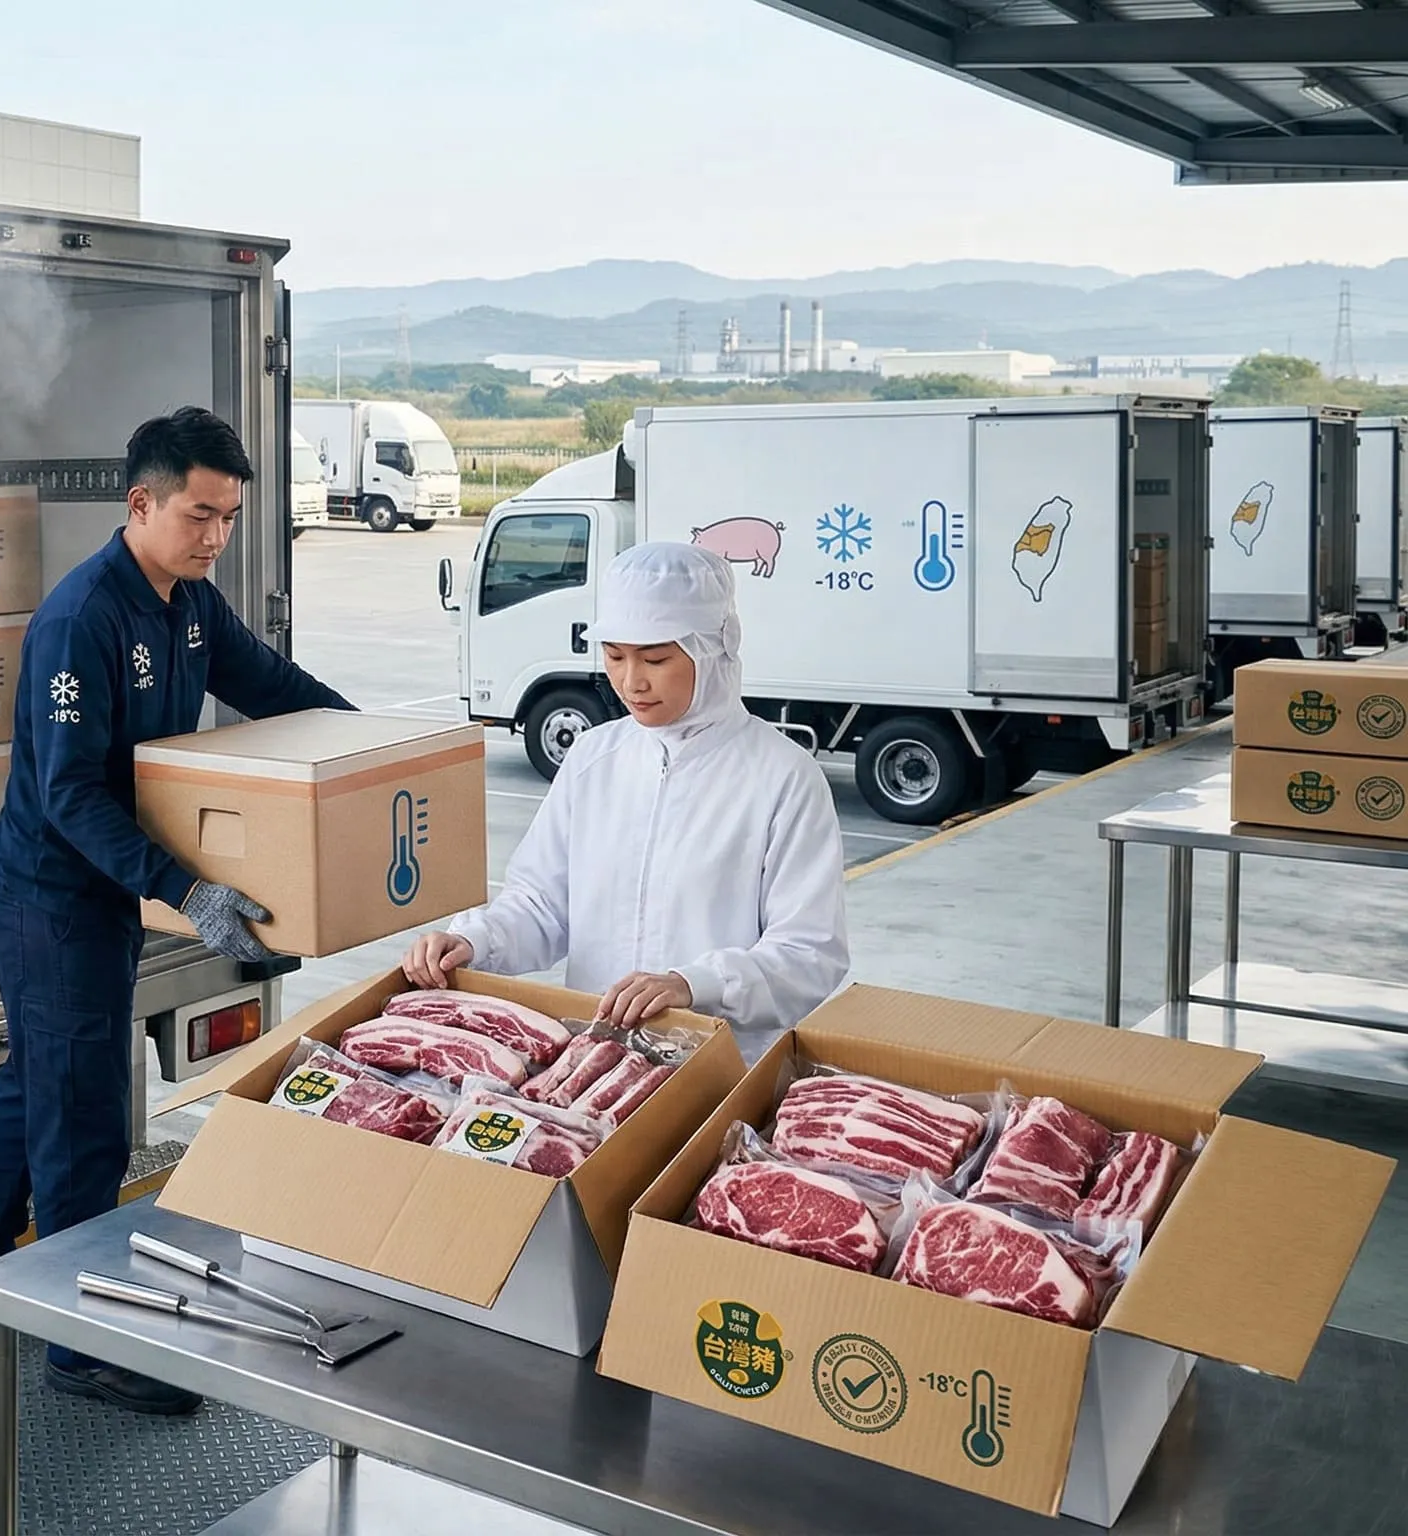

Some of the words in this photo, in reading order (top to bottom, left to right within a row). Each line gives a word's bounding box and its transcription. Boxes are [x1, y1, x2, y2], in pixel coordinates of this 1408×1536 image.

[815, 571, 874, 591] -18°C
[703, 1332, 775, 1376] 台灣豬
[919, 1372, 968, 1397] -18°C
